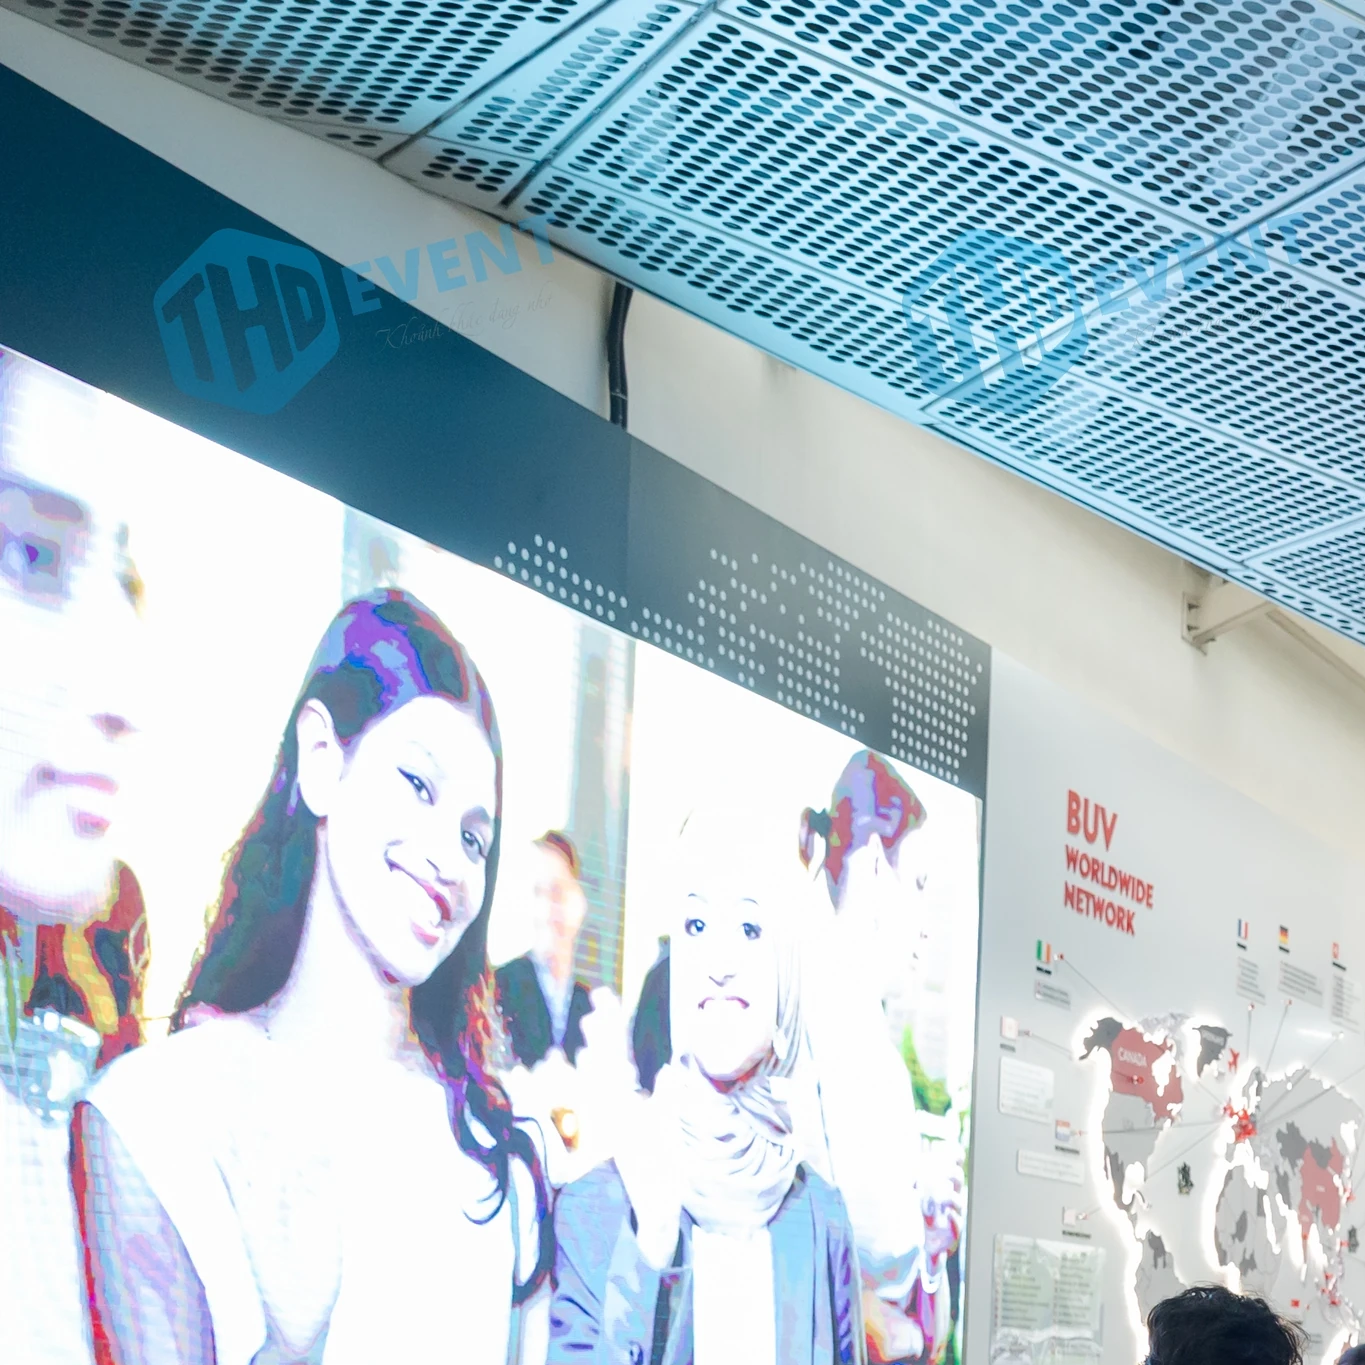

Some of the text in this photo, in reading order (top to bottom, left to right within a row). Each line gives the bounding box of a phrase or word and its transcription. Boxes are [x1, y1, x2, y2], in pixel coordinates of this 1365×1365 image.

[1067, 789, 1118, 852] BUV
[1064, 880, 1135, 937] NETWORK
[1065, 844, 1154, 910] WORLDWIDE
